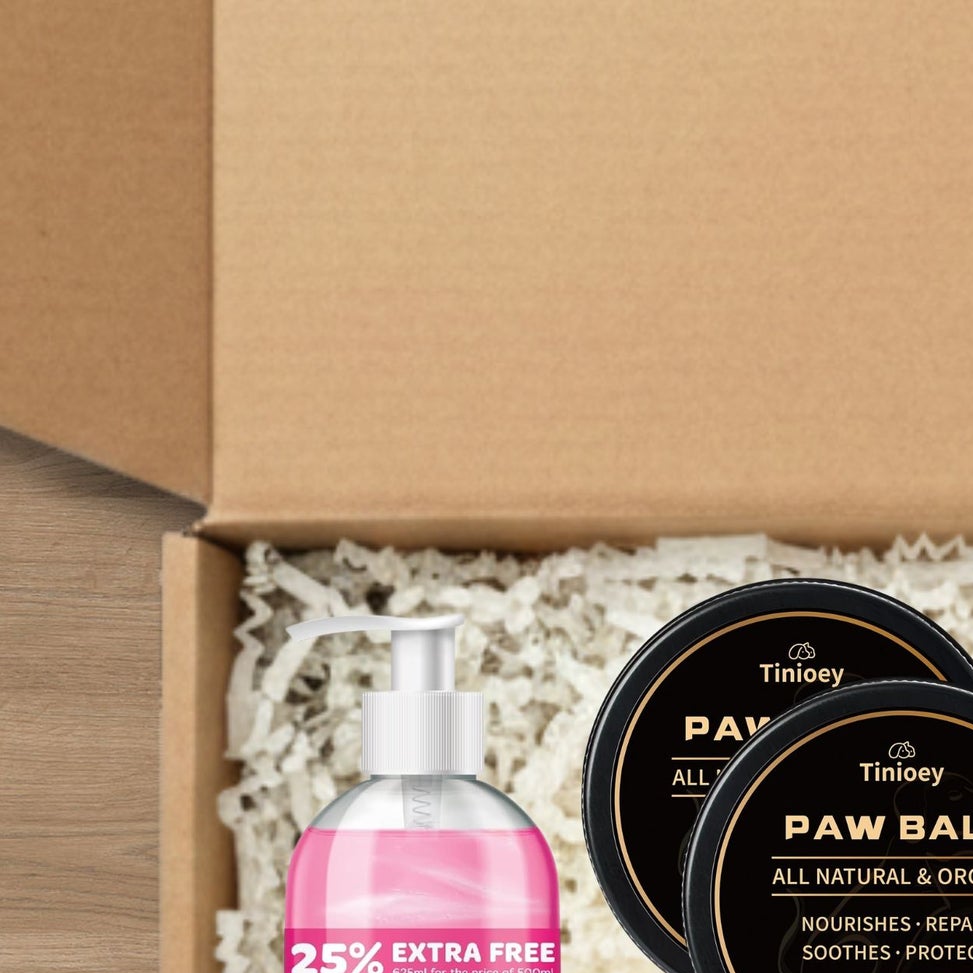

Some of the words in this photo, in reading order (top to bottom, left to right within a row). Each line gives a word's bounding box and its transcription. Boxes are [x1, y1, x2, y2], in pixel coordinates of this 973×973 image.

[759, 662, 845, 688] Tinioey
[672, 769, 710, 786] ALL
[859, 762, 945, 787] Tinioey
[784, 815, 886, 841] PAW
[772, 868, 810, 886] ALL
[815, 868, 911, 886] NATURAL
[916, 868, 933, 886] &
[801, 916, 912, 933] NOURISHES
[392, 942, 482, 963] EXTRA
[489, 942, 555, 963] FREE
[801, 945, 892, 962] SOOTHES
